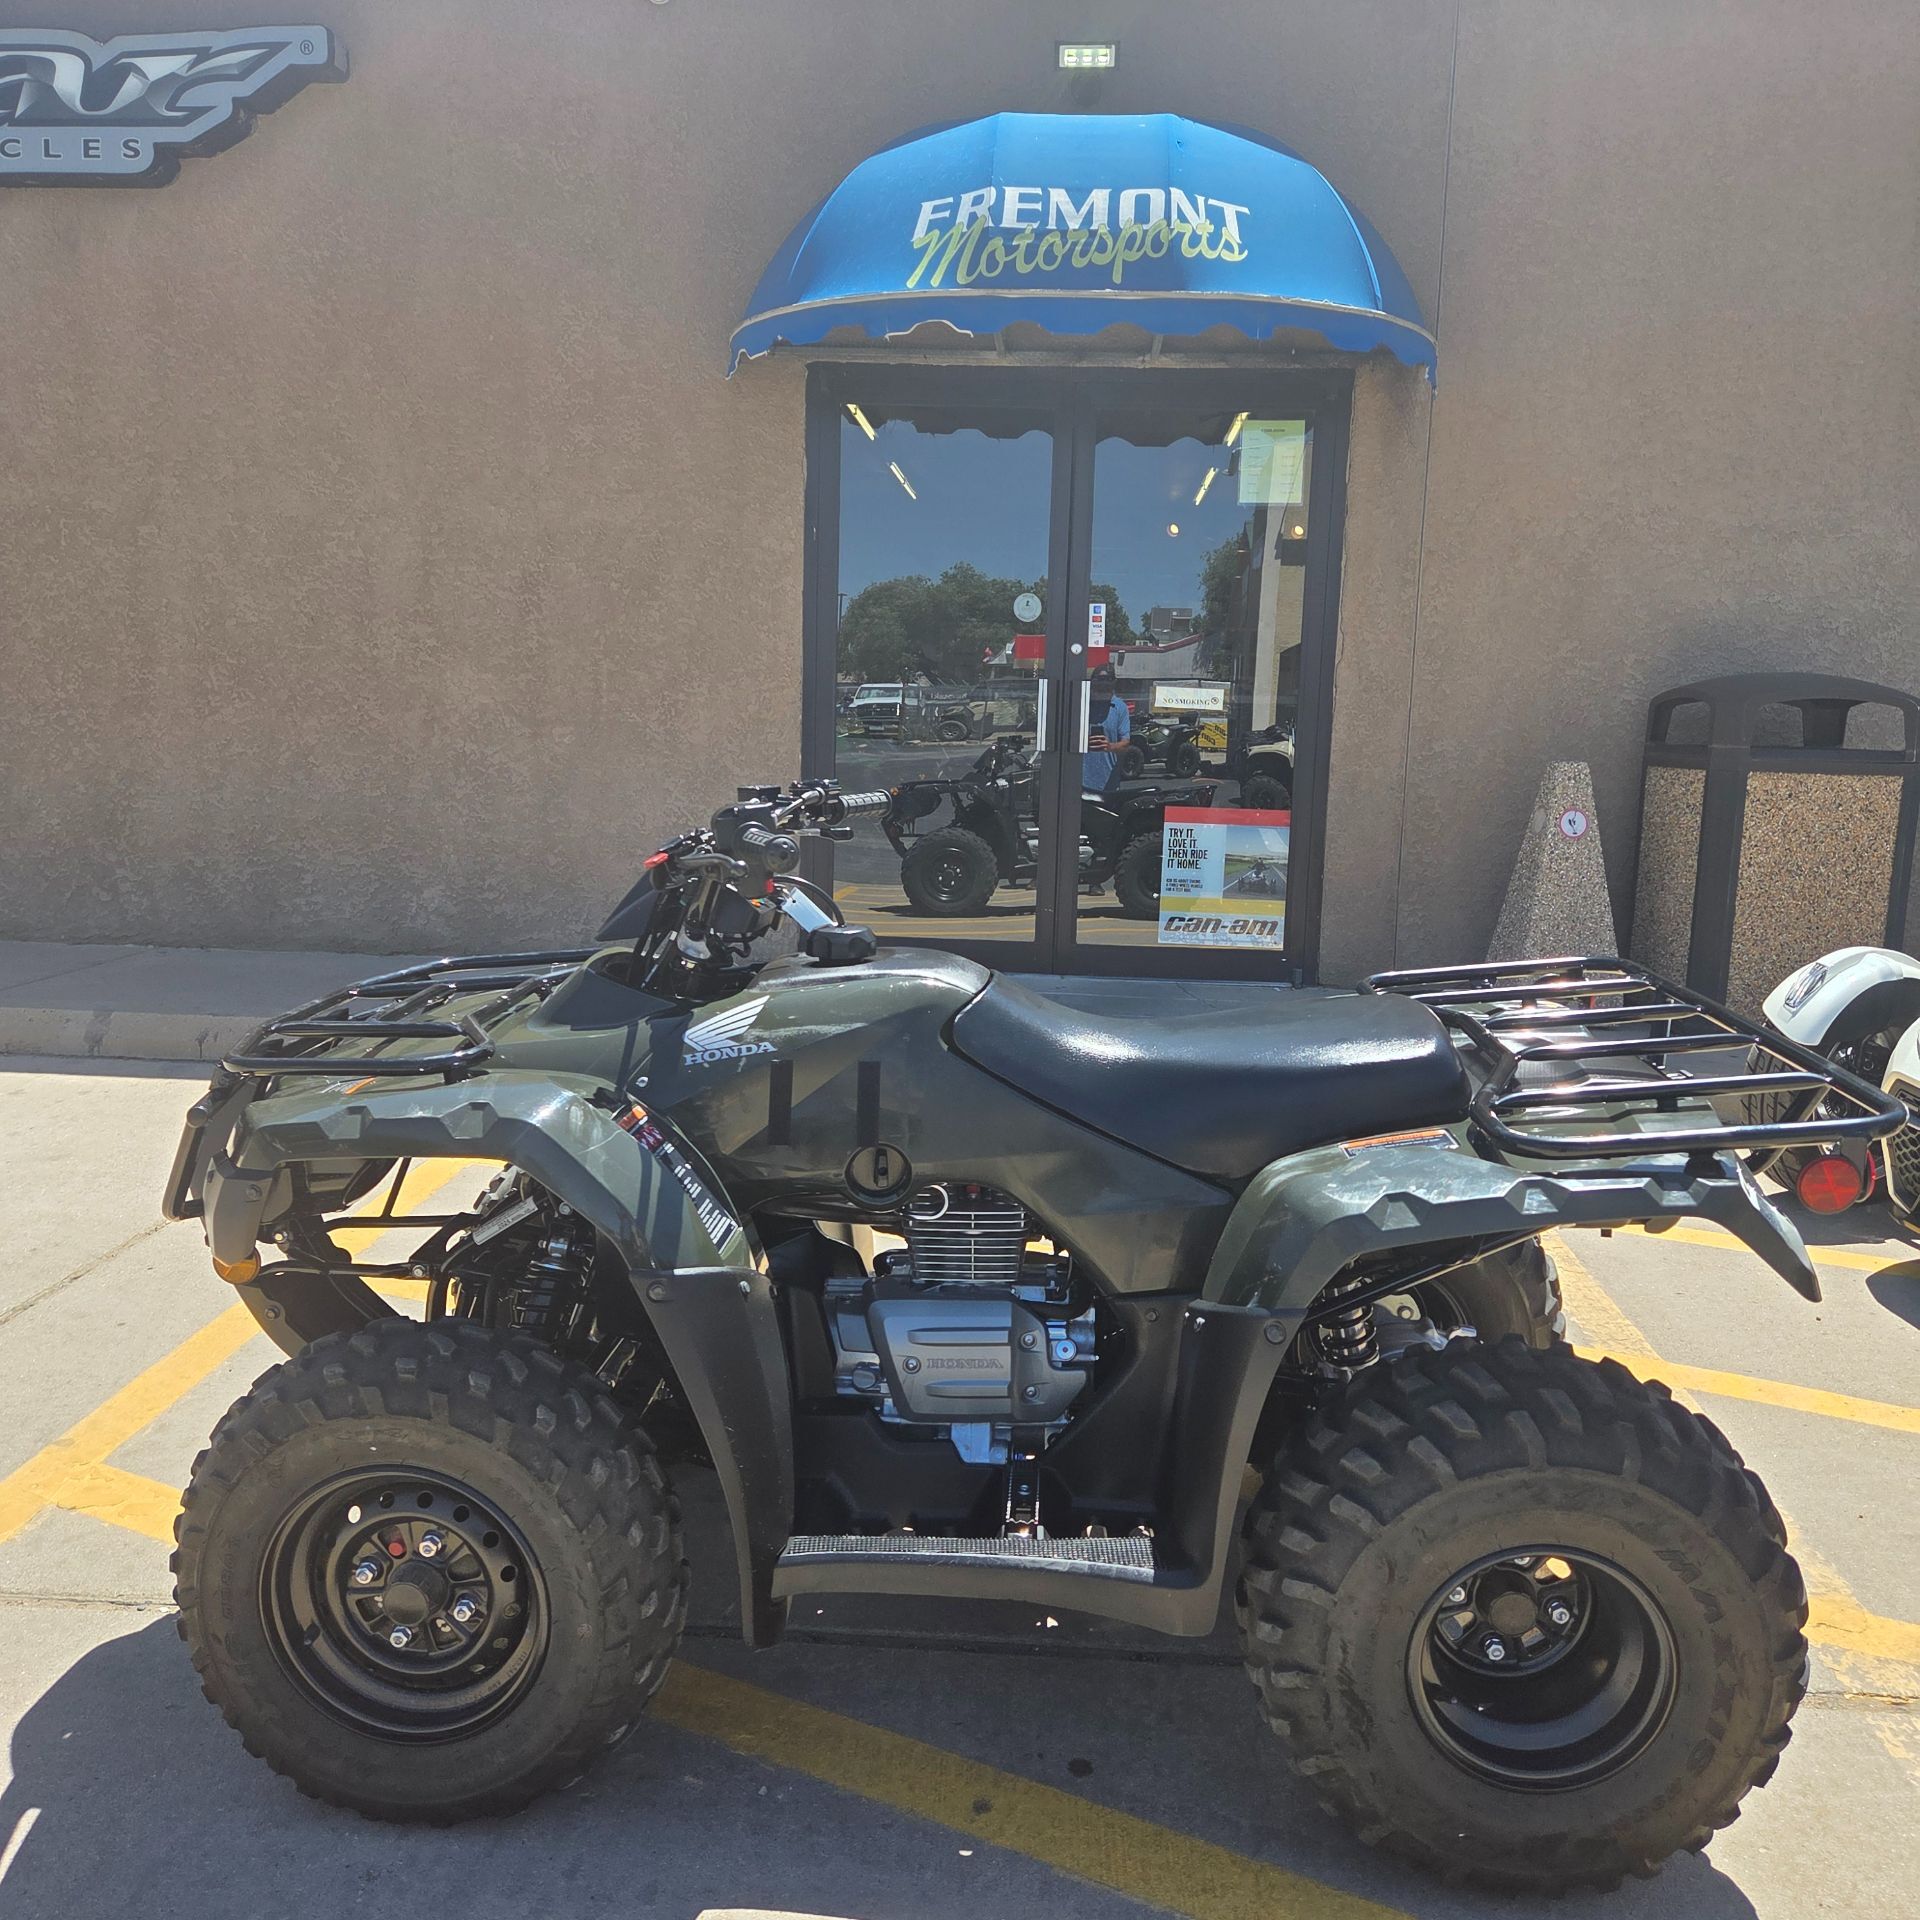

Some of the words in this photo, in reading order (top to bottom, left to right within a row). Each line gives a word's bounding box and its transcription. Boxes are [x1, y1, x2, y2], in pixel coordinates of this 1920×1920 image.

[912, 185, 1251, 245] FREMONT
[905, 214, 1249, 289] Motorsports
[1162, 697, 1174, 705] NO
[1174, 698, 1210, 706] SMOKING
[1168, 827, 1184, 838] TRY
[1168, 838, 1188, 849] LOVE
[1167, 848, 1188, 859] THEN
[1190, 849, 1209, 860] RIDE
[1167, 858, 1176, 869] IT
[682, 1041, 778, 1066] HONDA
[926, 1358, 1005, 1369] HONDA
